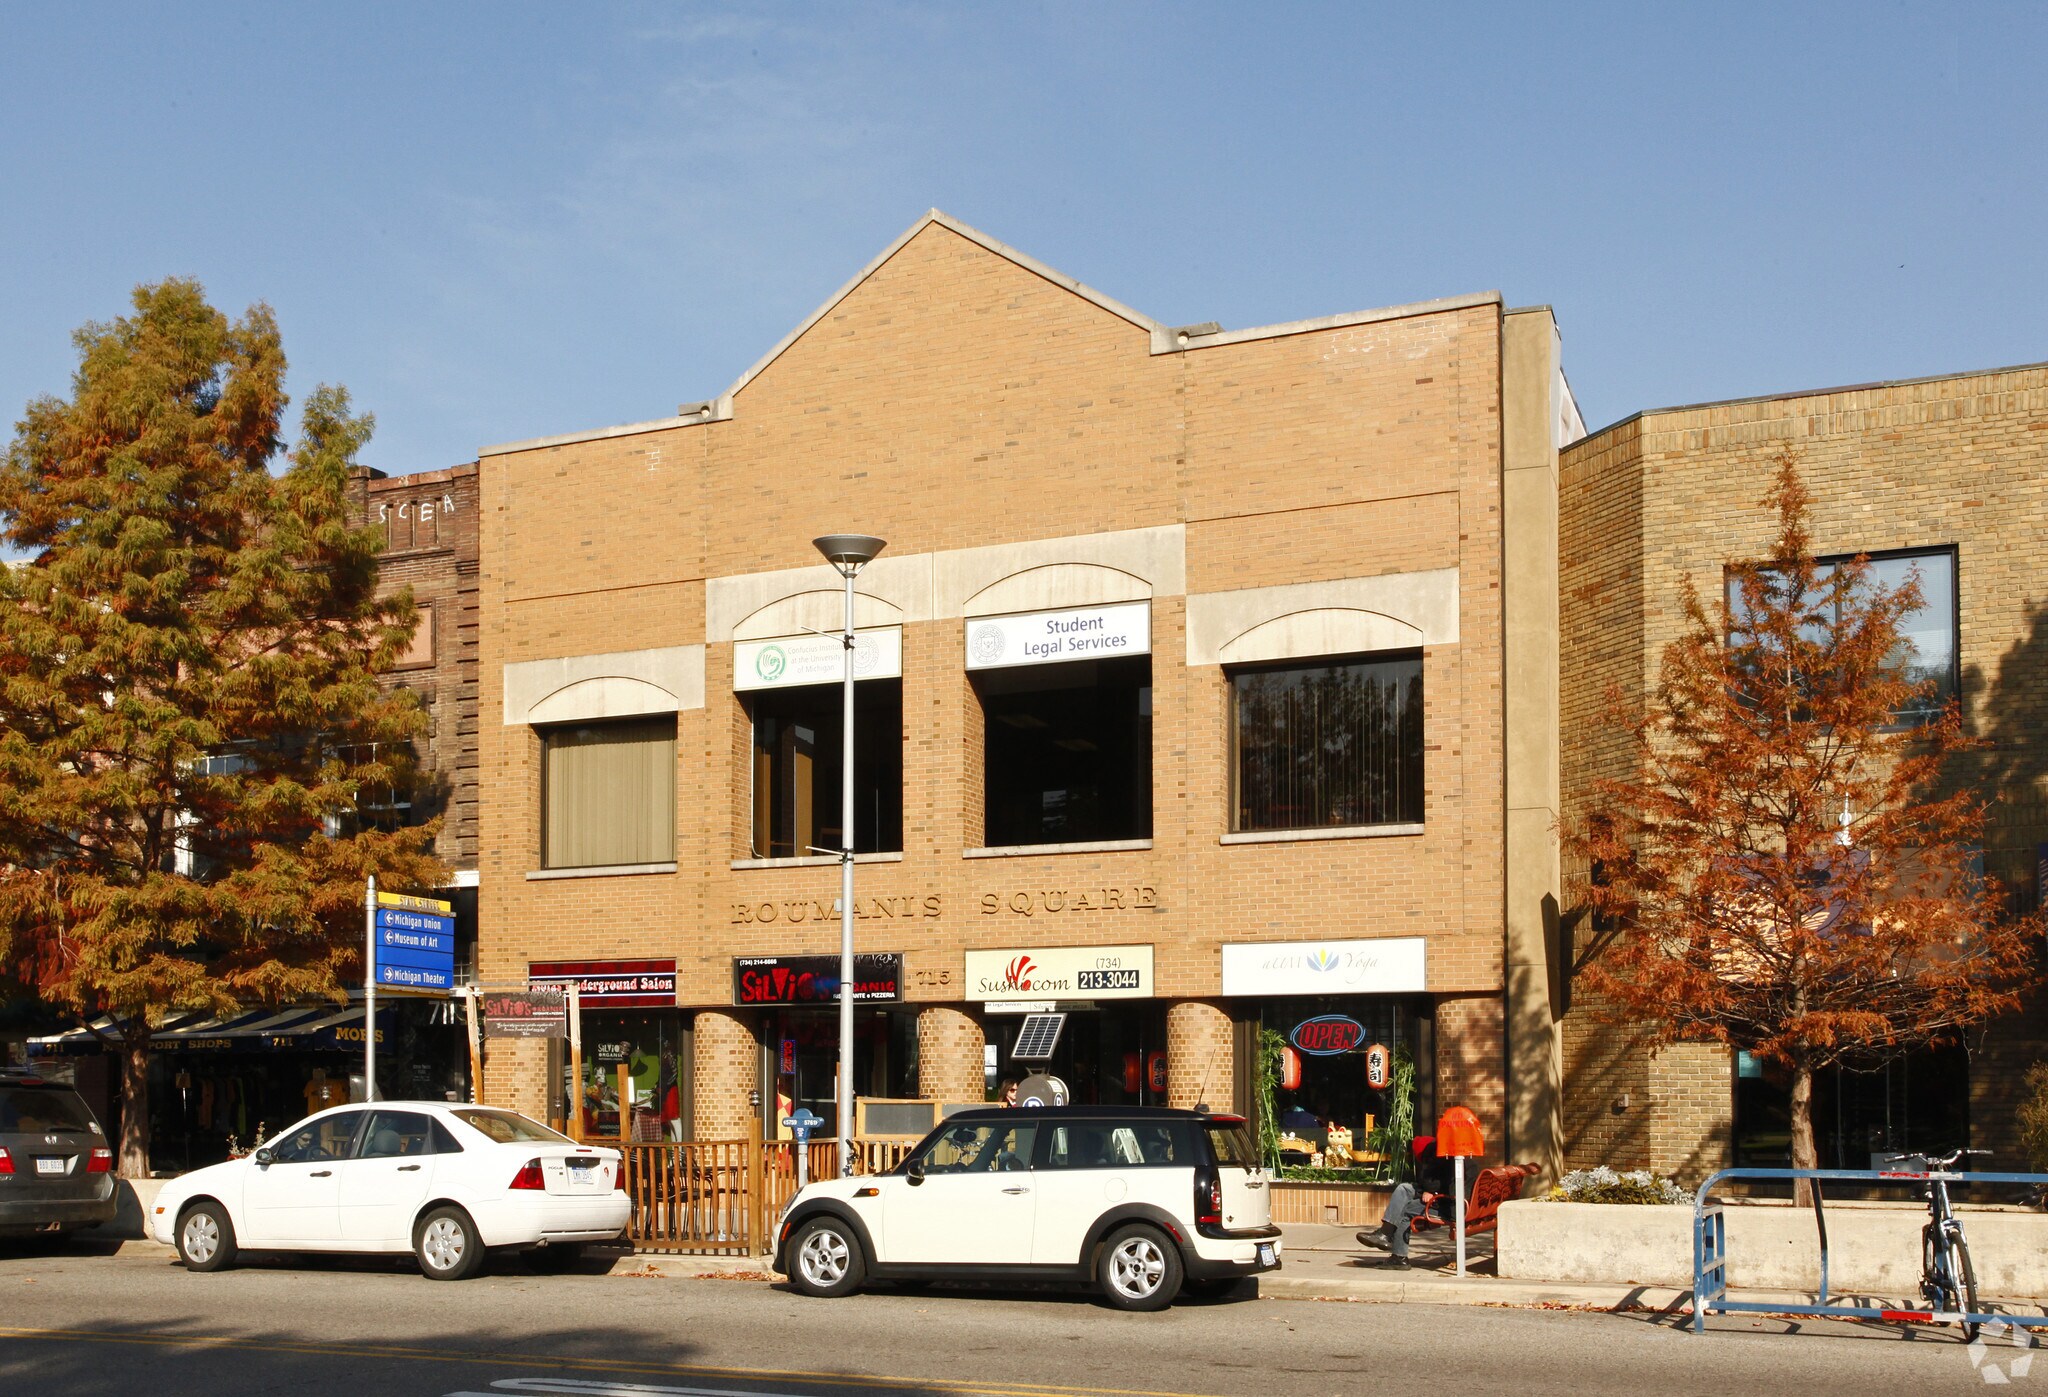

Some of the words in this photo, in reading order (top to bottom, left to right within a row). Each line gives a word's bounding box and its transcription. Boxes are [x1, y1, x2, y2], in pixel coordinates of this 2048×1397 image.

[1047, 616, 1103, 635] Student
[787, 646, 818, 655] Confucius
[1024, 637, 1062, 658] Legal
[1068, 634, 1127, 652] Services
[790, 656, 797, 665] at
[798, 655, 809, 663] the
[810, 653, 842, 664] University
[805, 664, 835, 675] Michigan
[731, 896, 942, 924] ROUMANIS
[980, 887, 1158, 917] SQUARE
[394, 913, 422, 930] Michigan
[423, 917, 441, 930] Union
[394, 932, 419, 946] Museum
[421, 935, 428, 946] of
[428, 936, 438, 947] Art
[1095, 957, 1121, 969] (734)
[1344, 951, 1379, 984] Yoga
[394, 968, 422, 985] Michigan
[423, 971, 445, 985] Theater
[640, 977, 673, 990] Salon
[916, 970, 952, 985] 715
[1080, 971, 1137, 989] 213-3044
[428, 1000, 455, 1025] 711
[148, 1040, 181, 1050] PORT
[188, 1039, 232, 1049] SHOPS
[1300, 1023, 1358, 1049] OPEN
[46, 1043, 64, 1053] 711
[784, 1041, 793, 1072] OPEN
